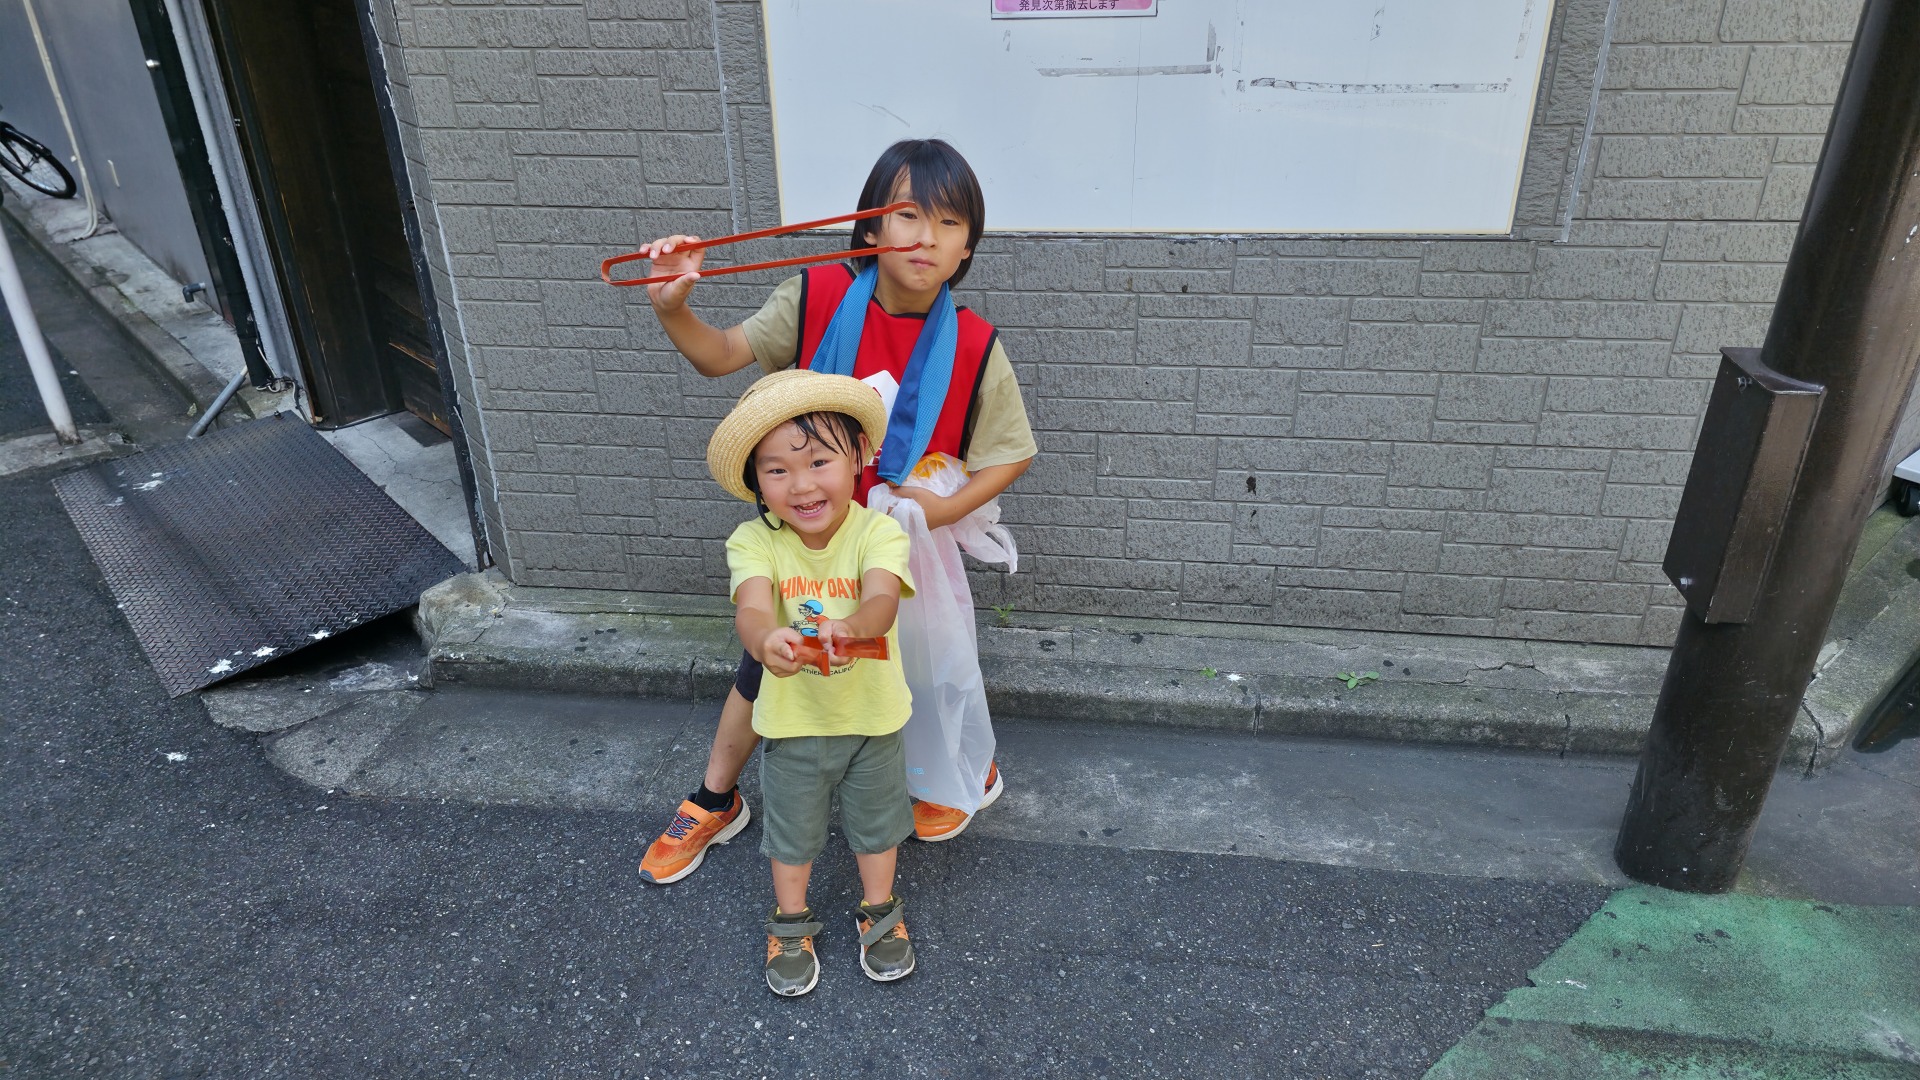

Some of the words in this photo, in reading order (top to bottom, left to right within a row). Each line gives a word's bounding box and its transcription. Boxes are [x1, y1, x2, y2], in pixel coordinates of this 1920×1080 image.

[1019, 0, 1119, 11] 発見次第撤去します
